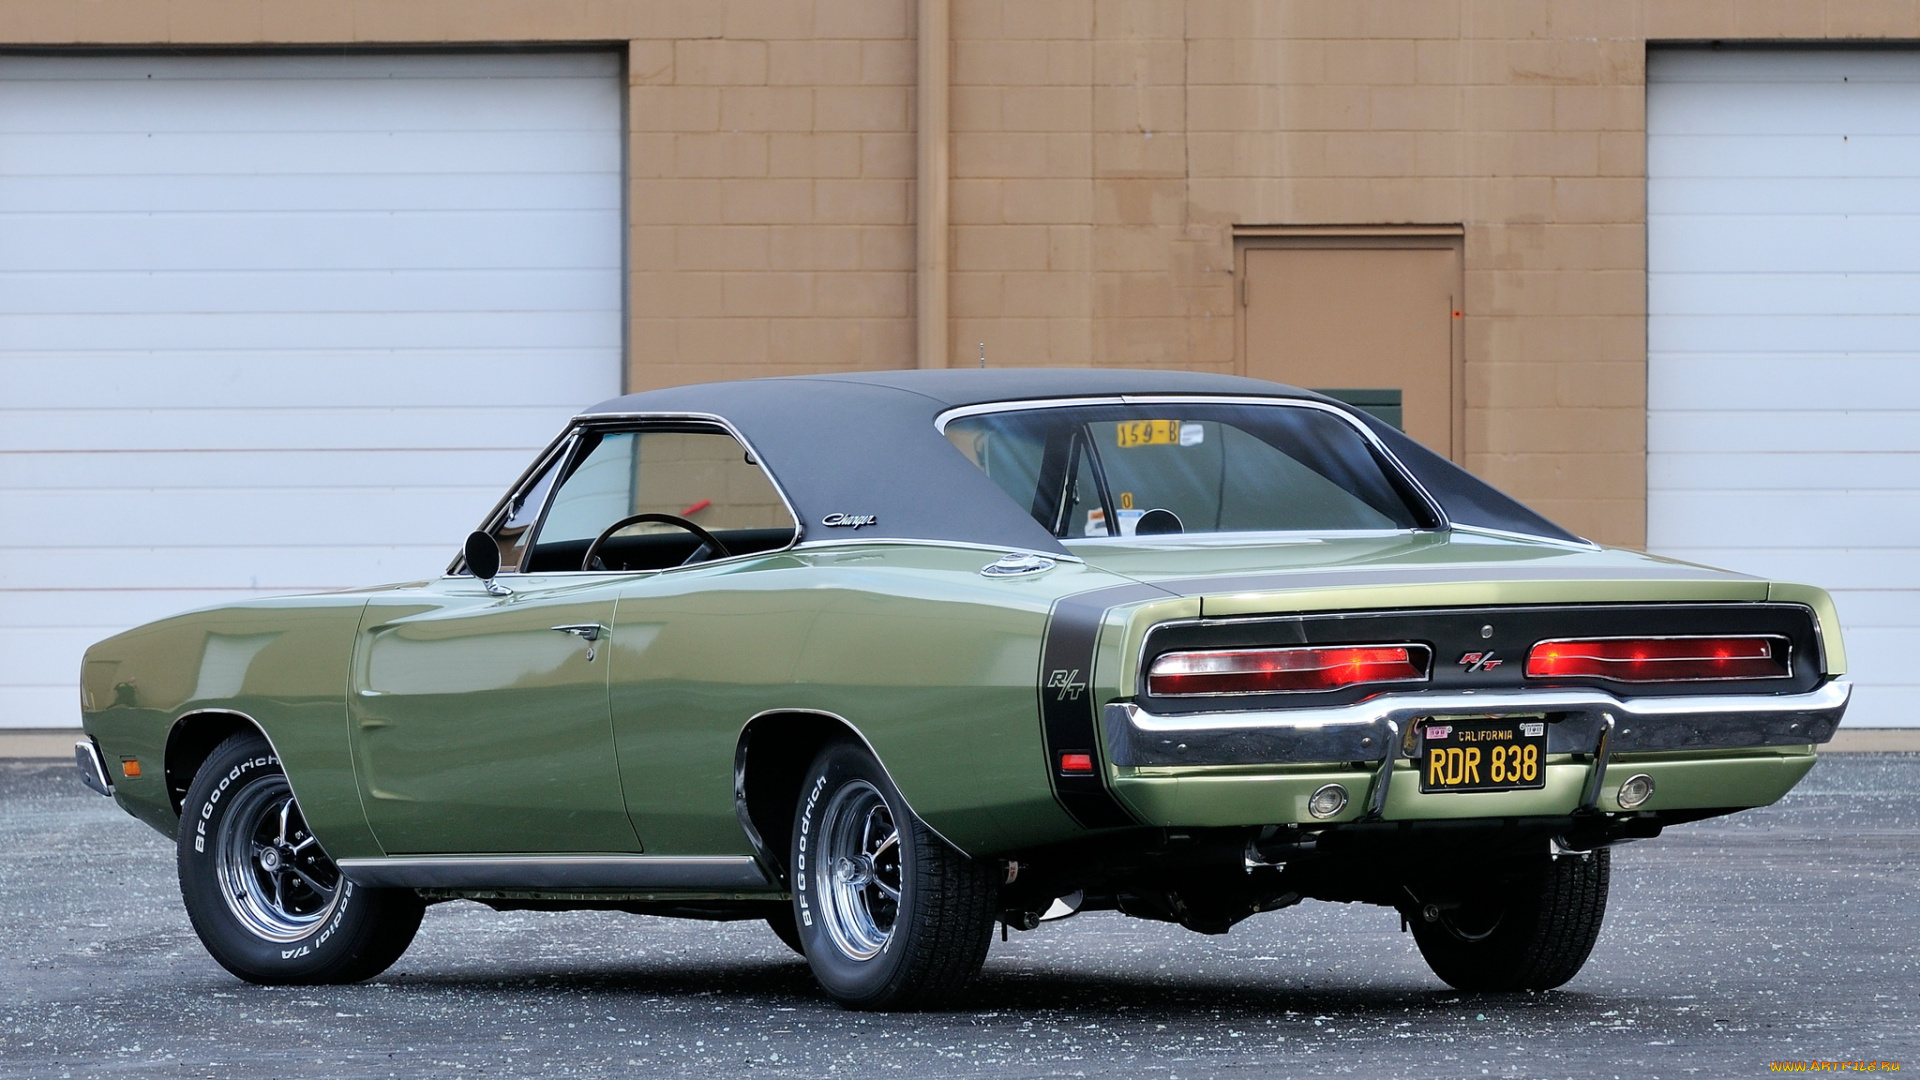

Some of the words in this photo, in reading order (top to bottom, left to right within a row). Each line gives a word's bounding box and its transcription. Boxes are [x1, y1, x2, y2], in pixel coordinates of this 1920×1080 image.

[1458, 651, 1503, 672] R/T
[1047, 669, 1086, 700] R/T
[1458, 730, 1513, 742] CALIFORNIA
[1430, 747, 1481, 785] RDR
[1491, 744, 1538, 783] 838
[195, 755, 281, 853] BFGoodrich
[798, 775, 827, 926] BFGoodrich
[315, 880, 353, 949] Radial
[281, 947, 311, 960] T/A
